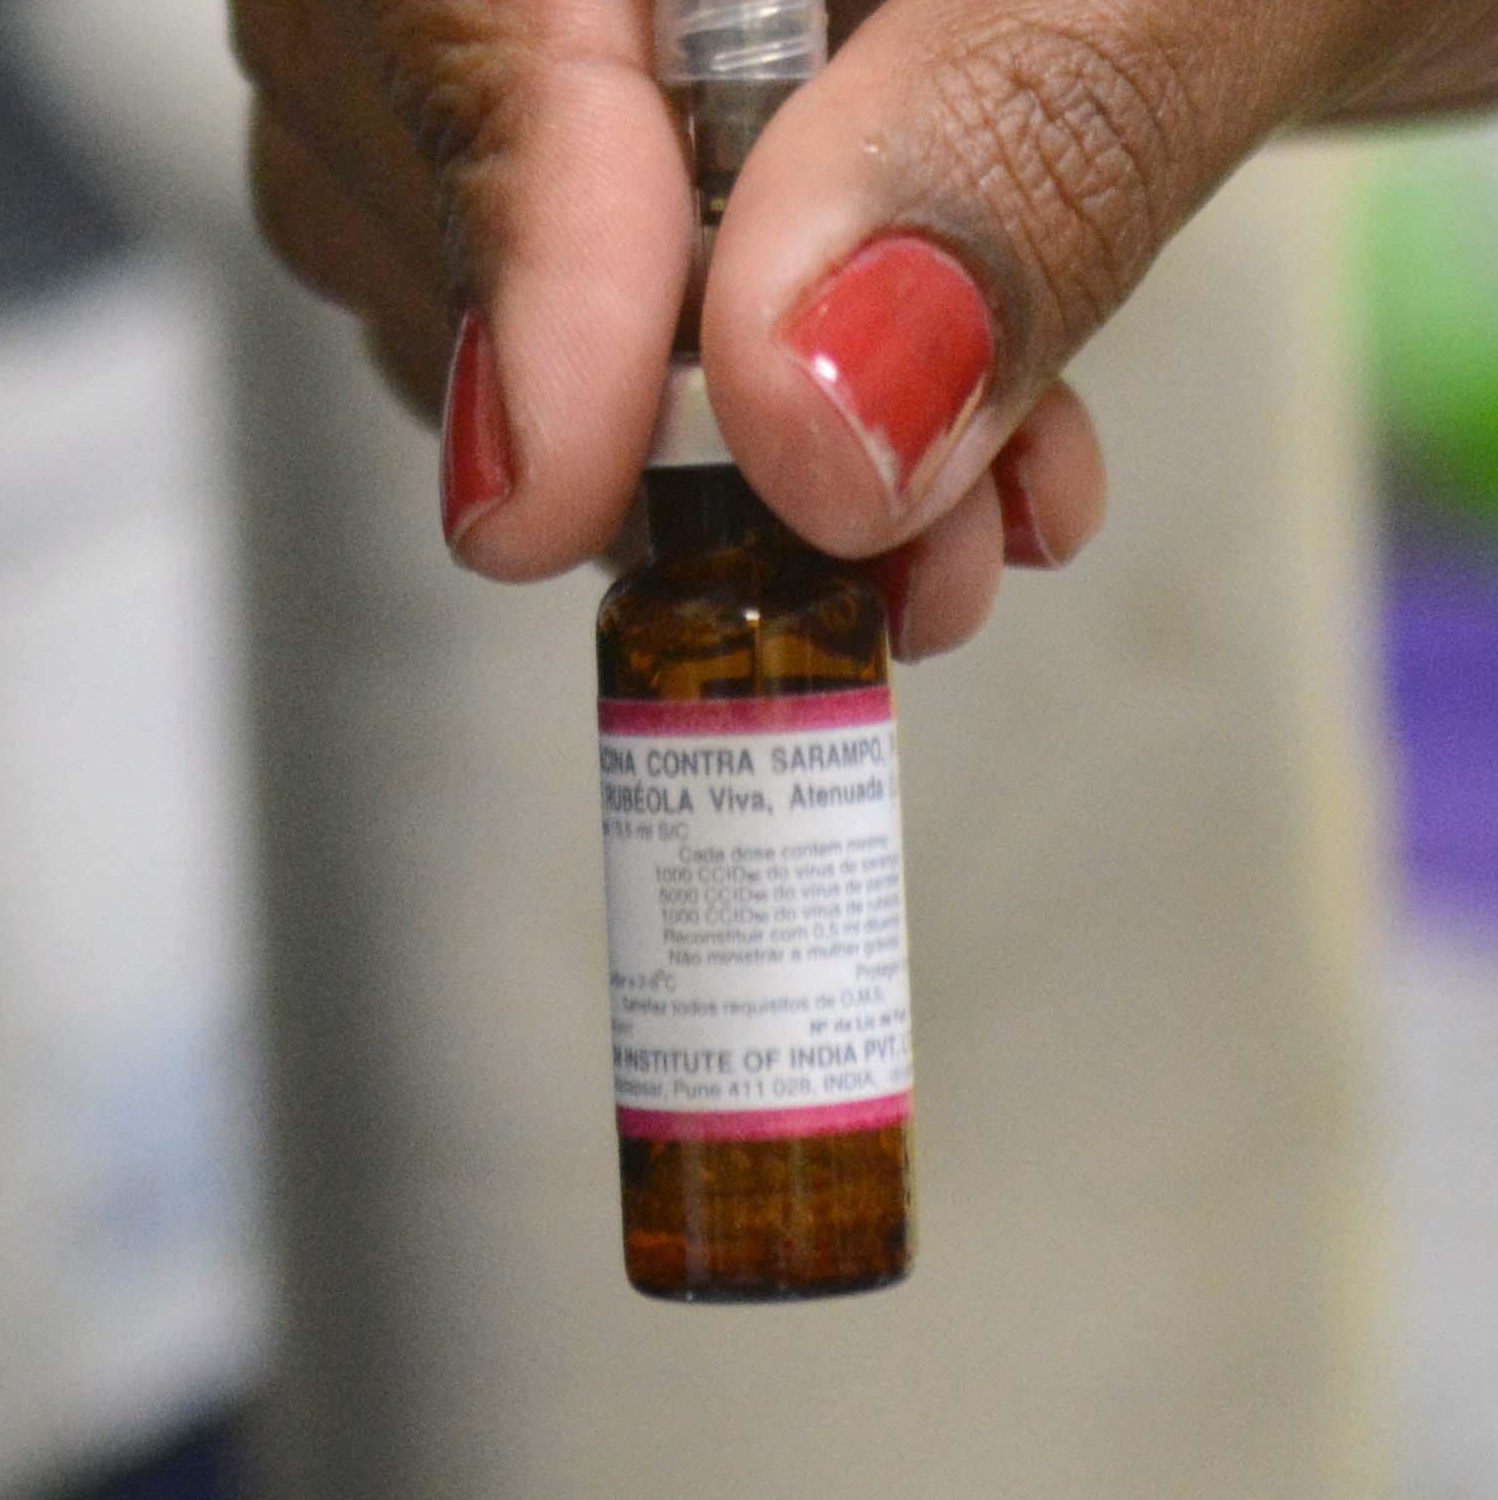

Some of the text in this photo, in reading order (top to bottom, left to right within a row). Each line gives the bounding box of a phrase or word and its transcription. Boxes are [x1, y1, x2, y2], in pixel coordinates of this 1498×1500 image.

[646, 748, 755, 778] CONTRA
[709, 786, 774, 816] Viva,
[790, 775, 885, 812] Atenuada
[678, 846, 724, 863] Cada
[625, 1045, 734, 1076] INSTITUTE
[742, 1047, 782, 1075] OF
[789, 1041, 858, 1071] INDIA
[673, 1077, 722, 1099] Pune
[727, 1075, 764, 1099] 411
